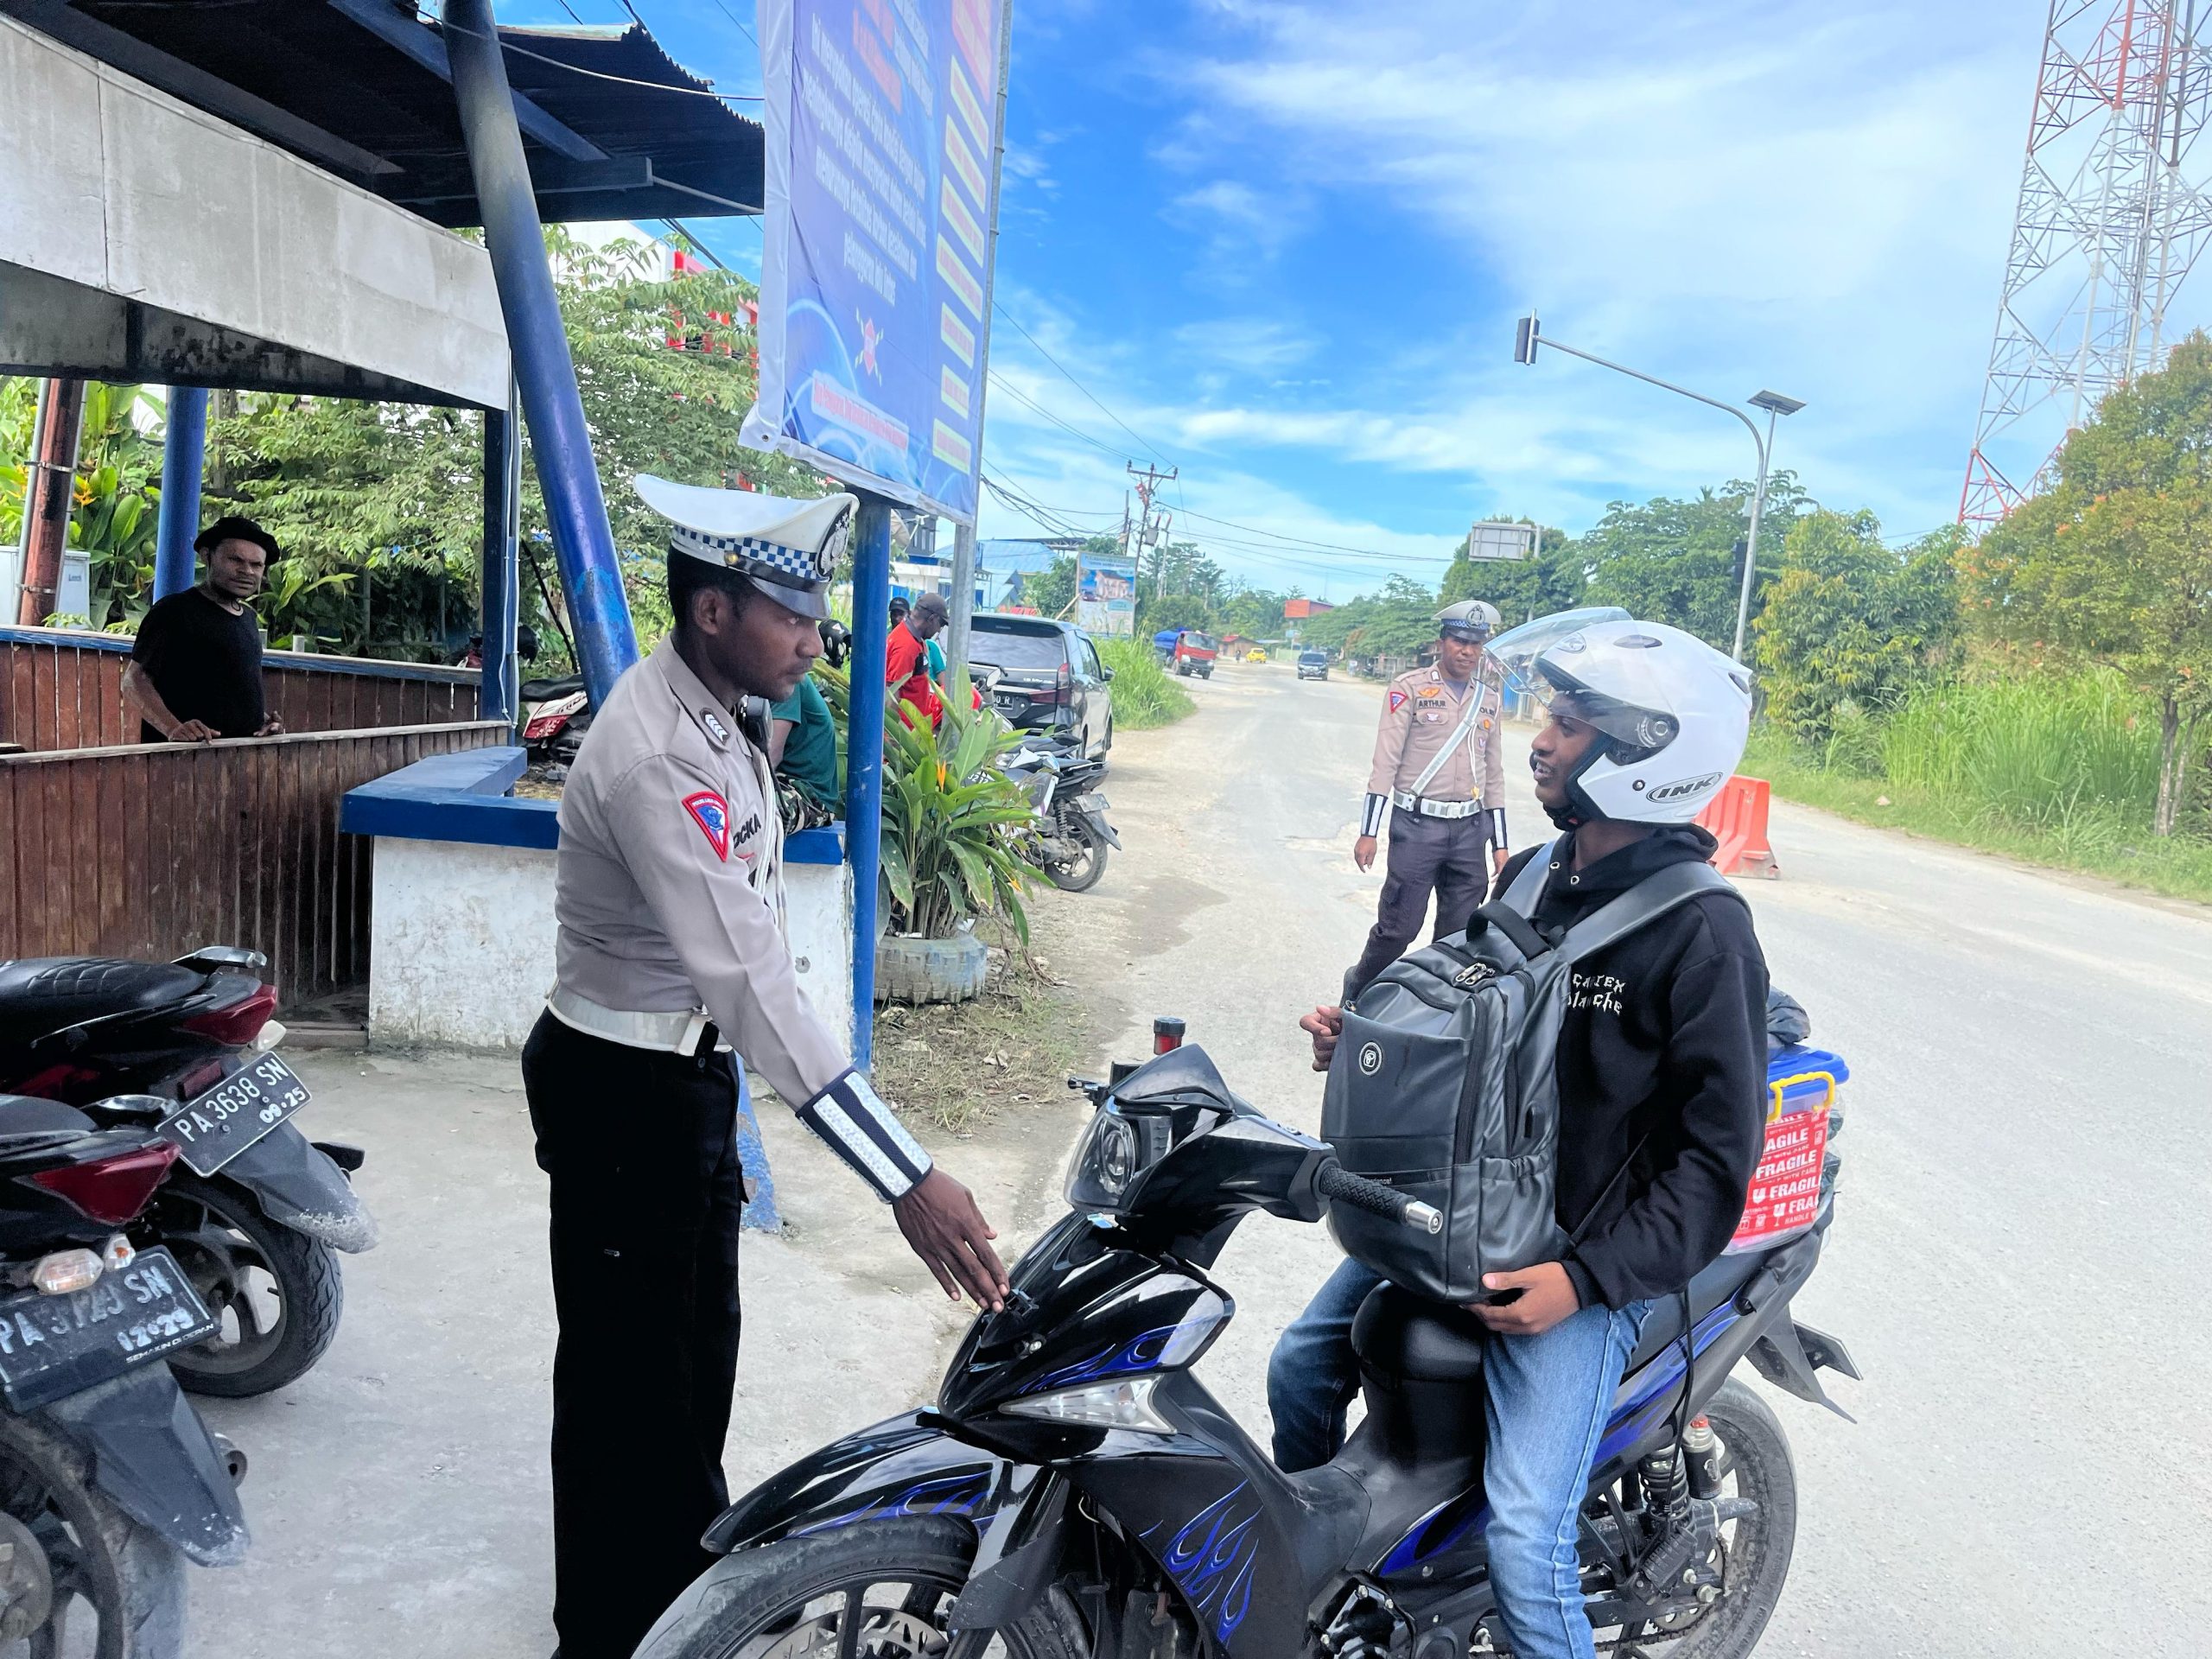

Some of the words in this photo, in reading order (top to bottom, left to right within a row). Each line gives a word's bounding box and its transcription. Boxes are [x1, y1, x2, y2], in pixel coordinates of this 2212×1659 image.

[1419, 700, 1446, 709] ARTHUR
[1657, 776, 1715, 798] INK
[175, 1111, 214, 1143] PA
[206, 1077, 261, 1121] 3638
[255, 1058, 289, 1086] SN
[1756, 1149, 1817, 1179] FRAGILE
[124, 1265, 173, 1304] SN
